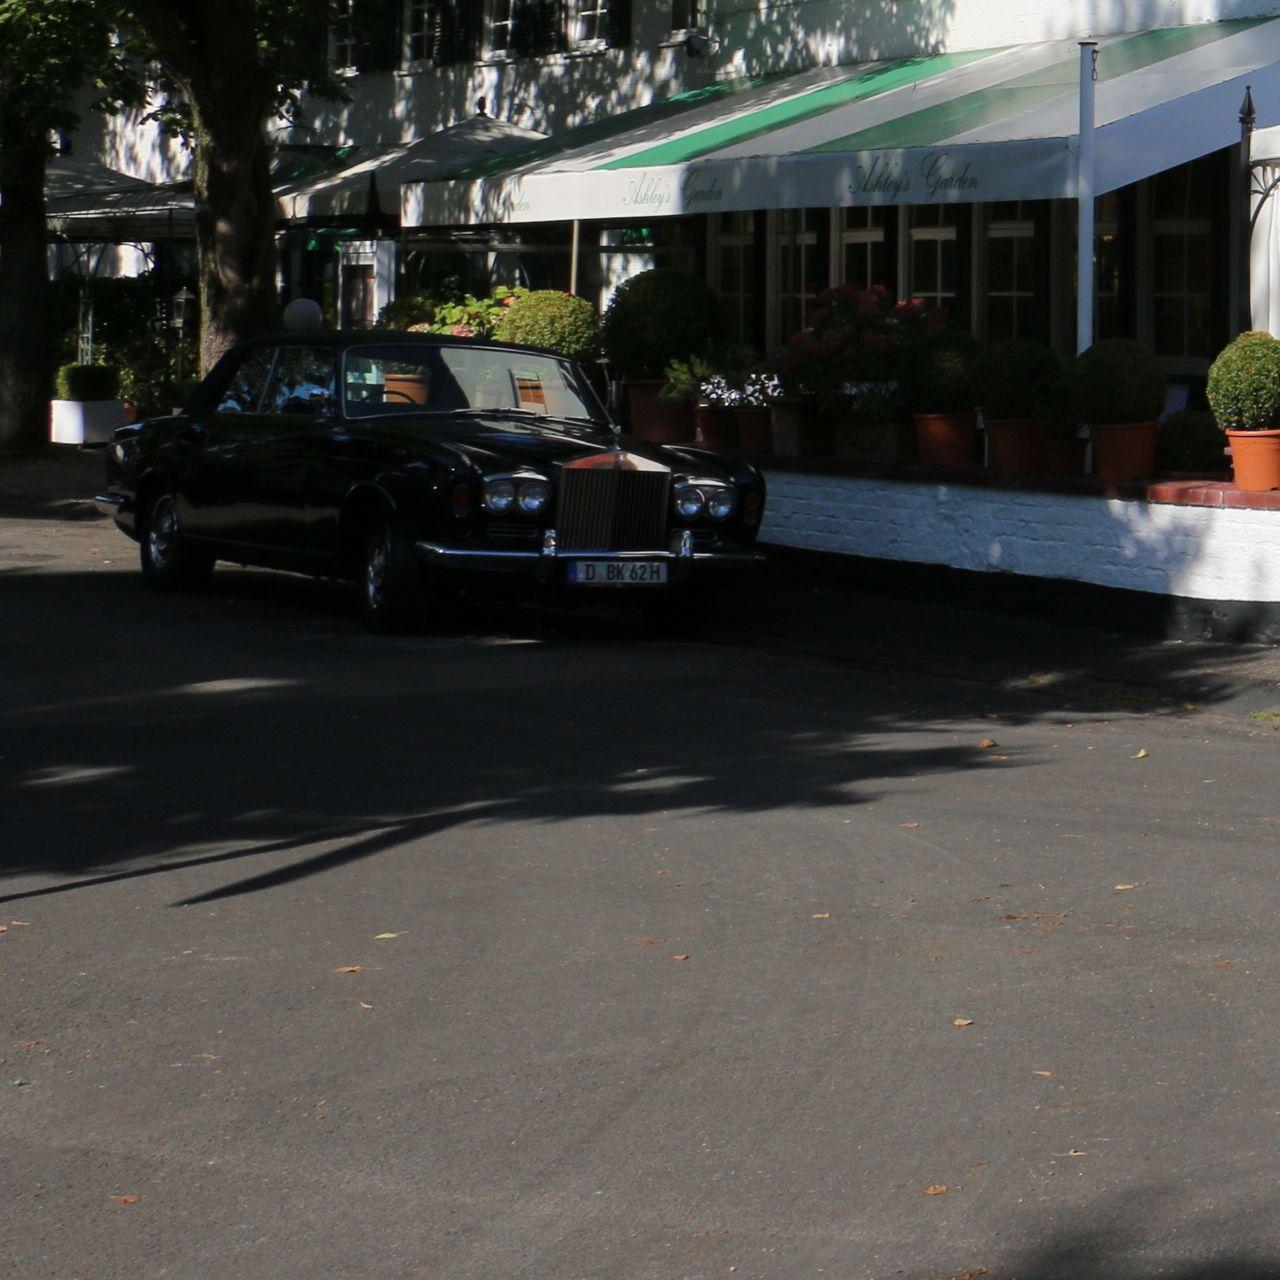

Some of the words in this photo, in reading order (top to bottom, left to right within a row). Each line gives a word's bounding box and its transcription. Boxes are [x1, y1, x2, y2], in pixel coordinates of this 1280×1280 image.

[921, 152, 978, 201] Garden
[586, 564, 596, 580] D
[607, 564, 625, 580] BK
